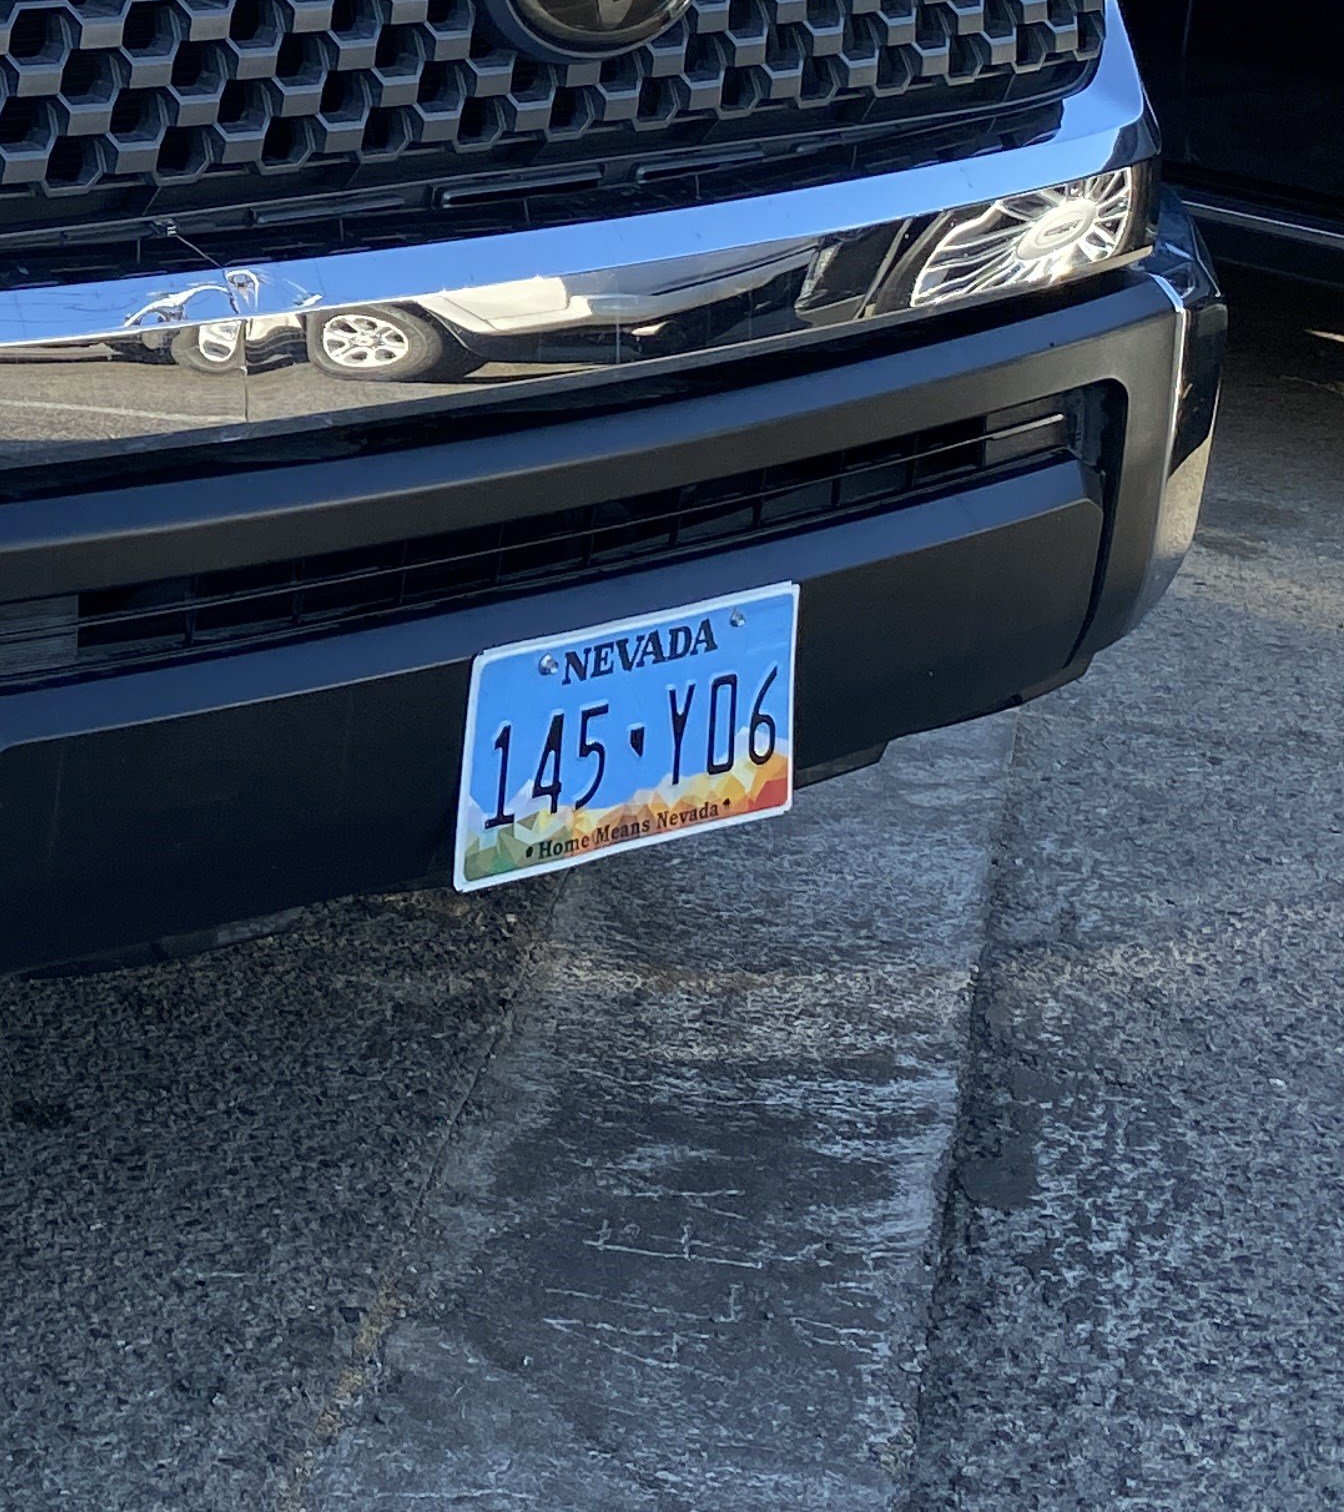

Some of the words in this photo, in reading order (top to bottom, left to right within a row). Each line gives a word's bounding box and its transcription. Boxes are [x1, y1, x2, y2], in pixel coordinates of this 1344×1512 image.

[561, 618, 718, 686] NEVADA
[537, 834, 590, 860] Home
[594, 819, 650, 845] Means
[656, 803, 719, 829] Nevada
